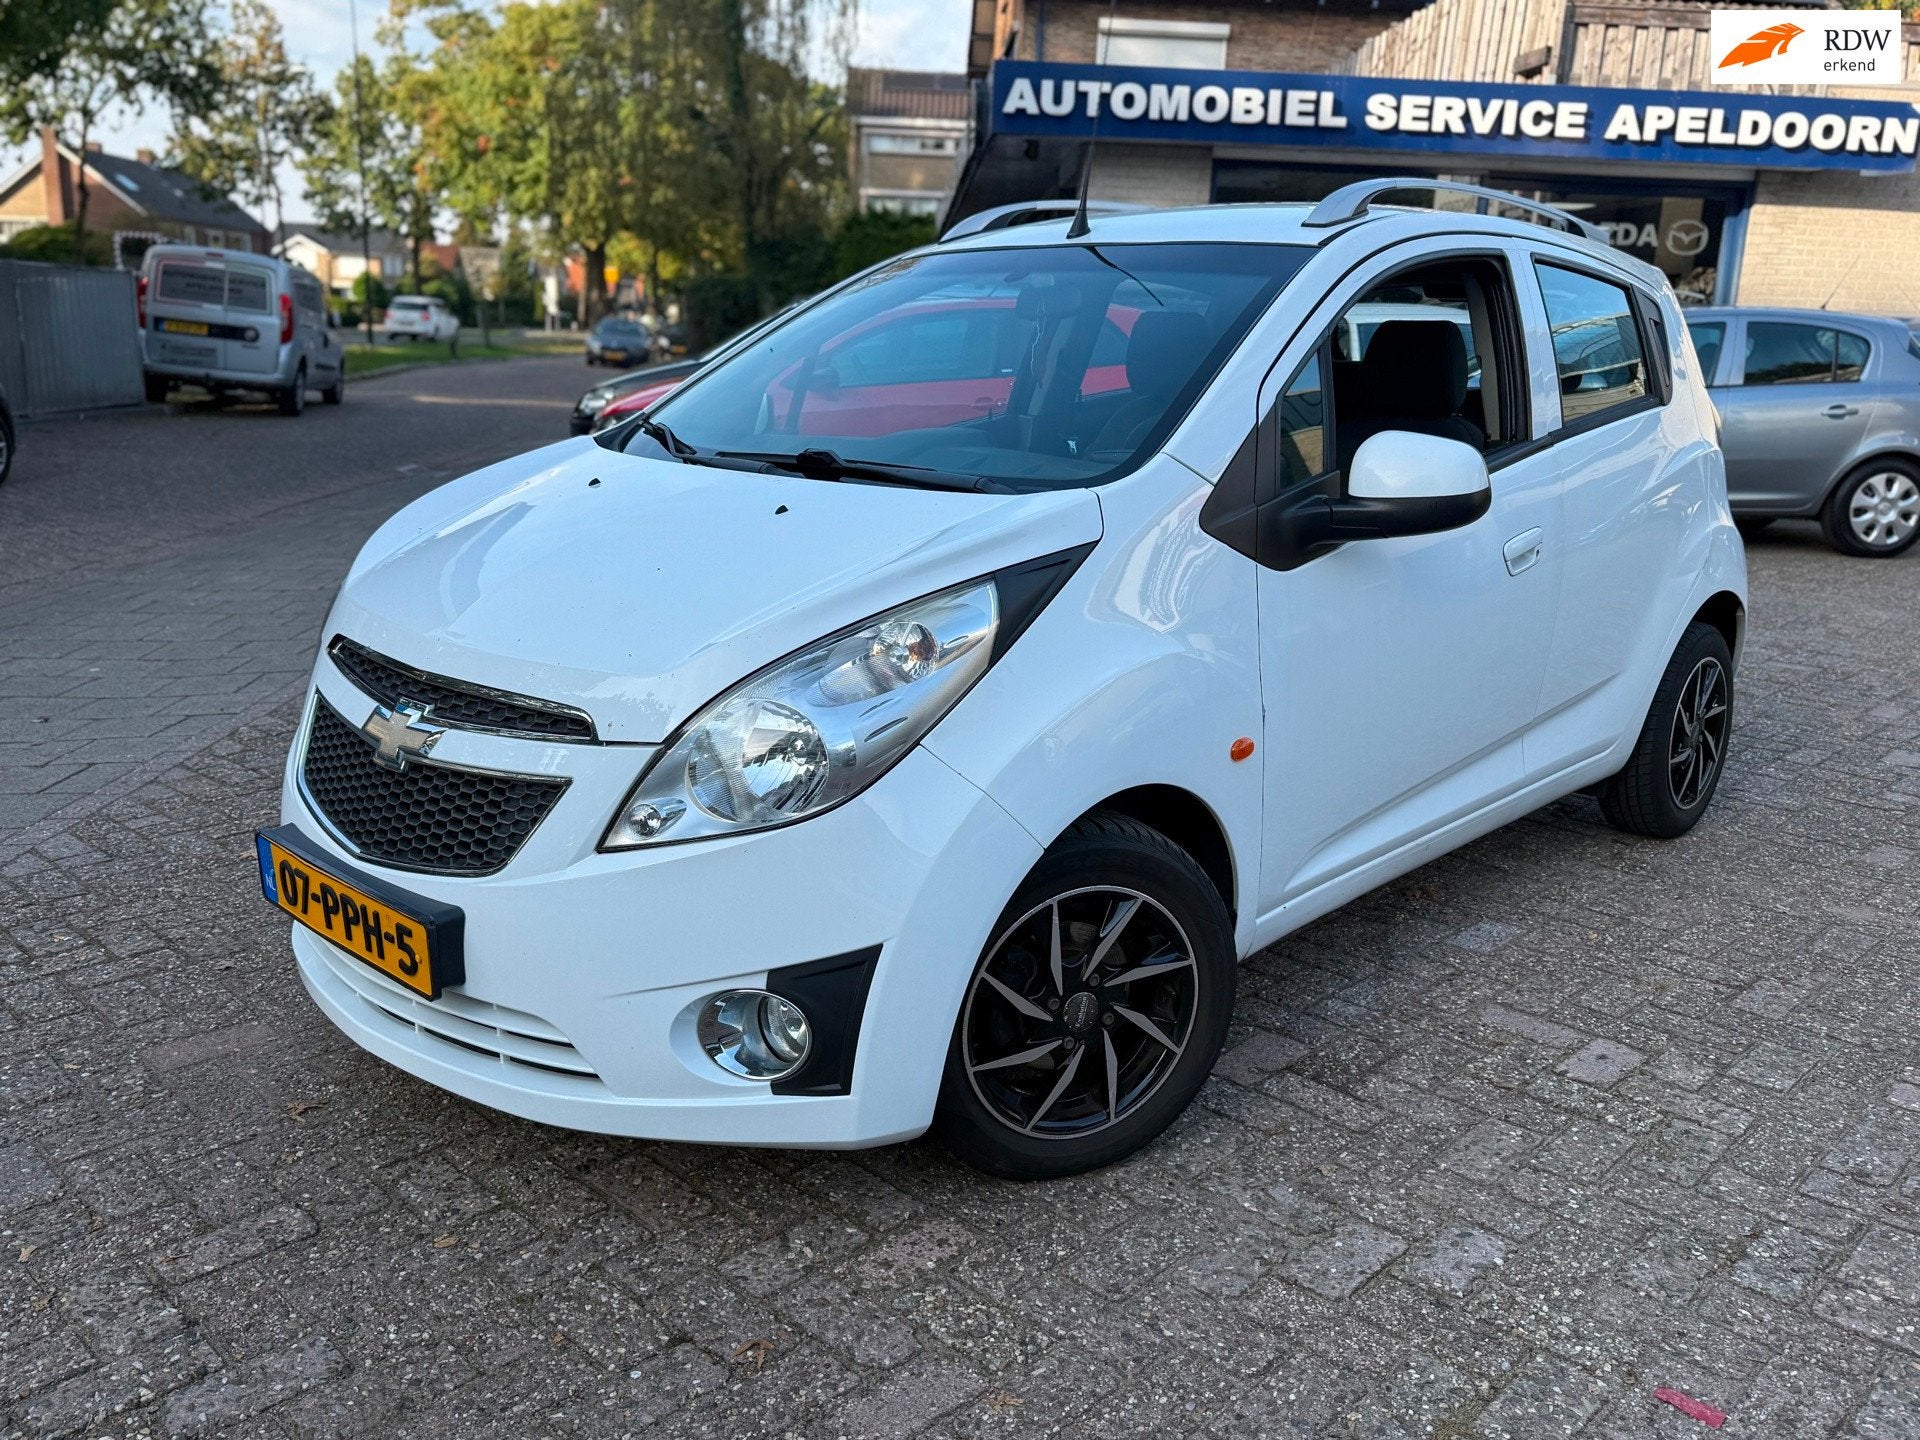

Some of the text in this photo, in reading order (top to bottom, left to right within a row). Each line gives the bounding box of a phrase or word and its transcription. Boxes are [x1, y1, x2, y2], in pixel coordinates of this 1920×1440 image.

[1002, 77, 1920, 154] AUTOMOBIEL SERVICE APELDOORN
[264, 873, 276, 891] NL
[279, 859, 418, 976] 07-PPH-5
